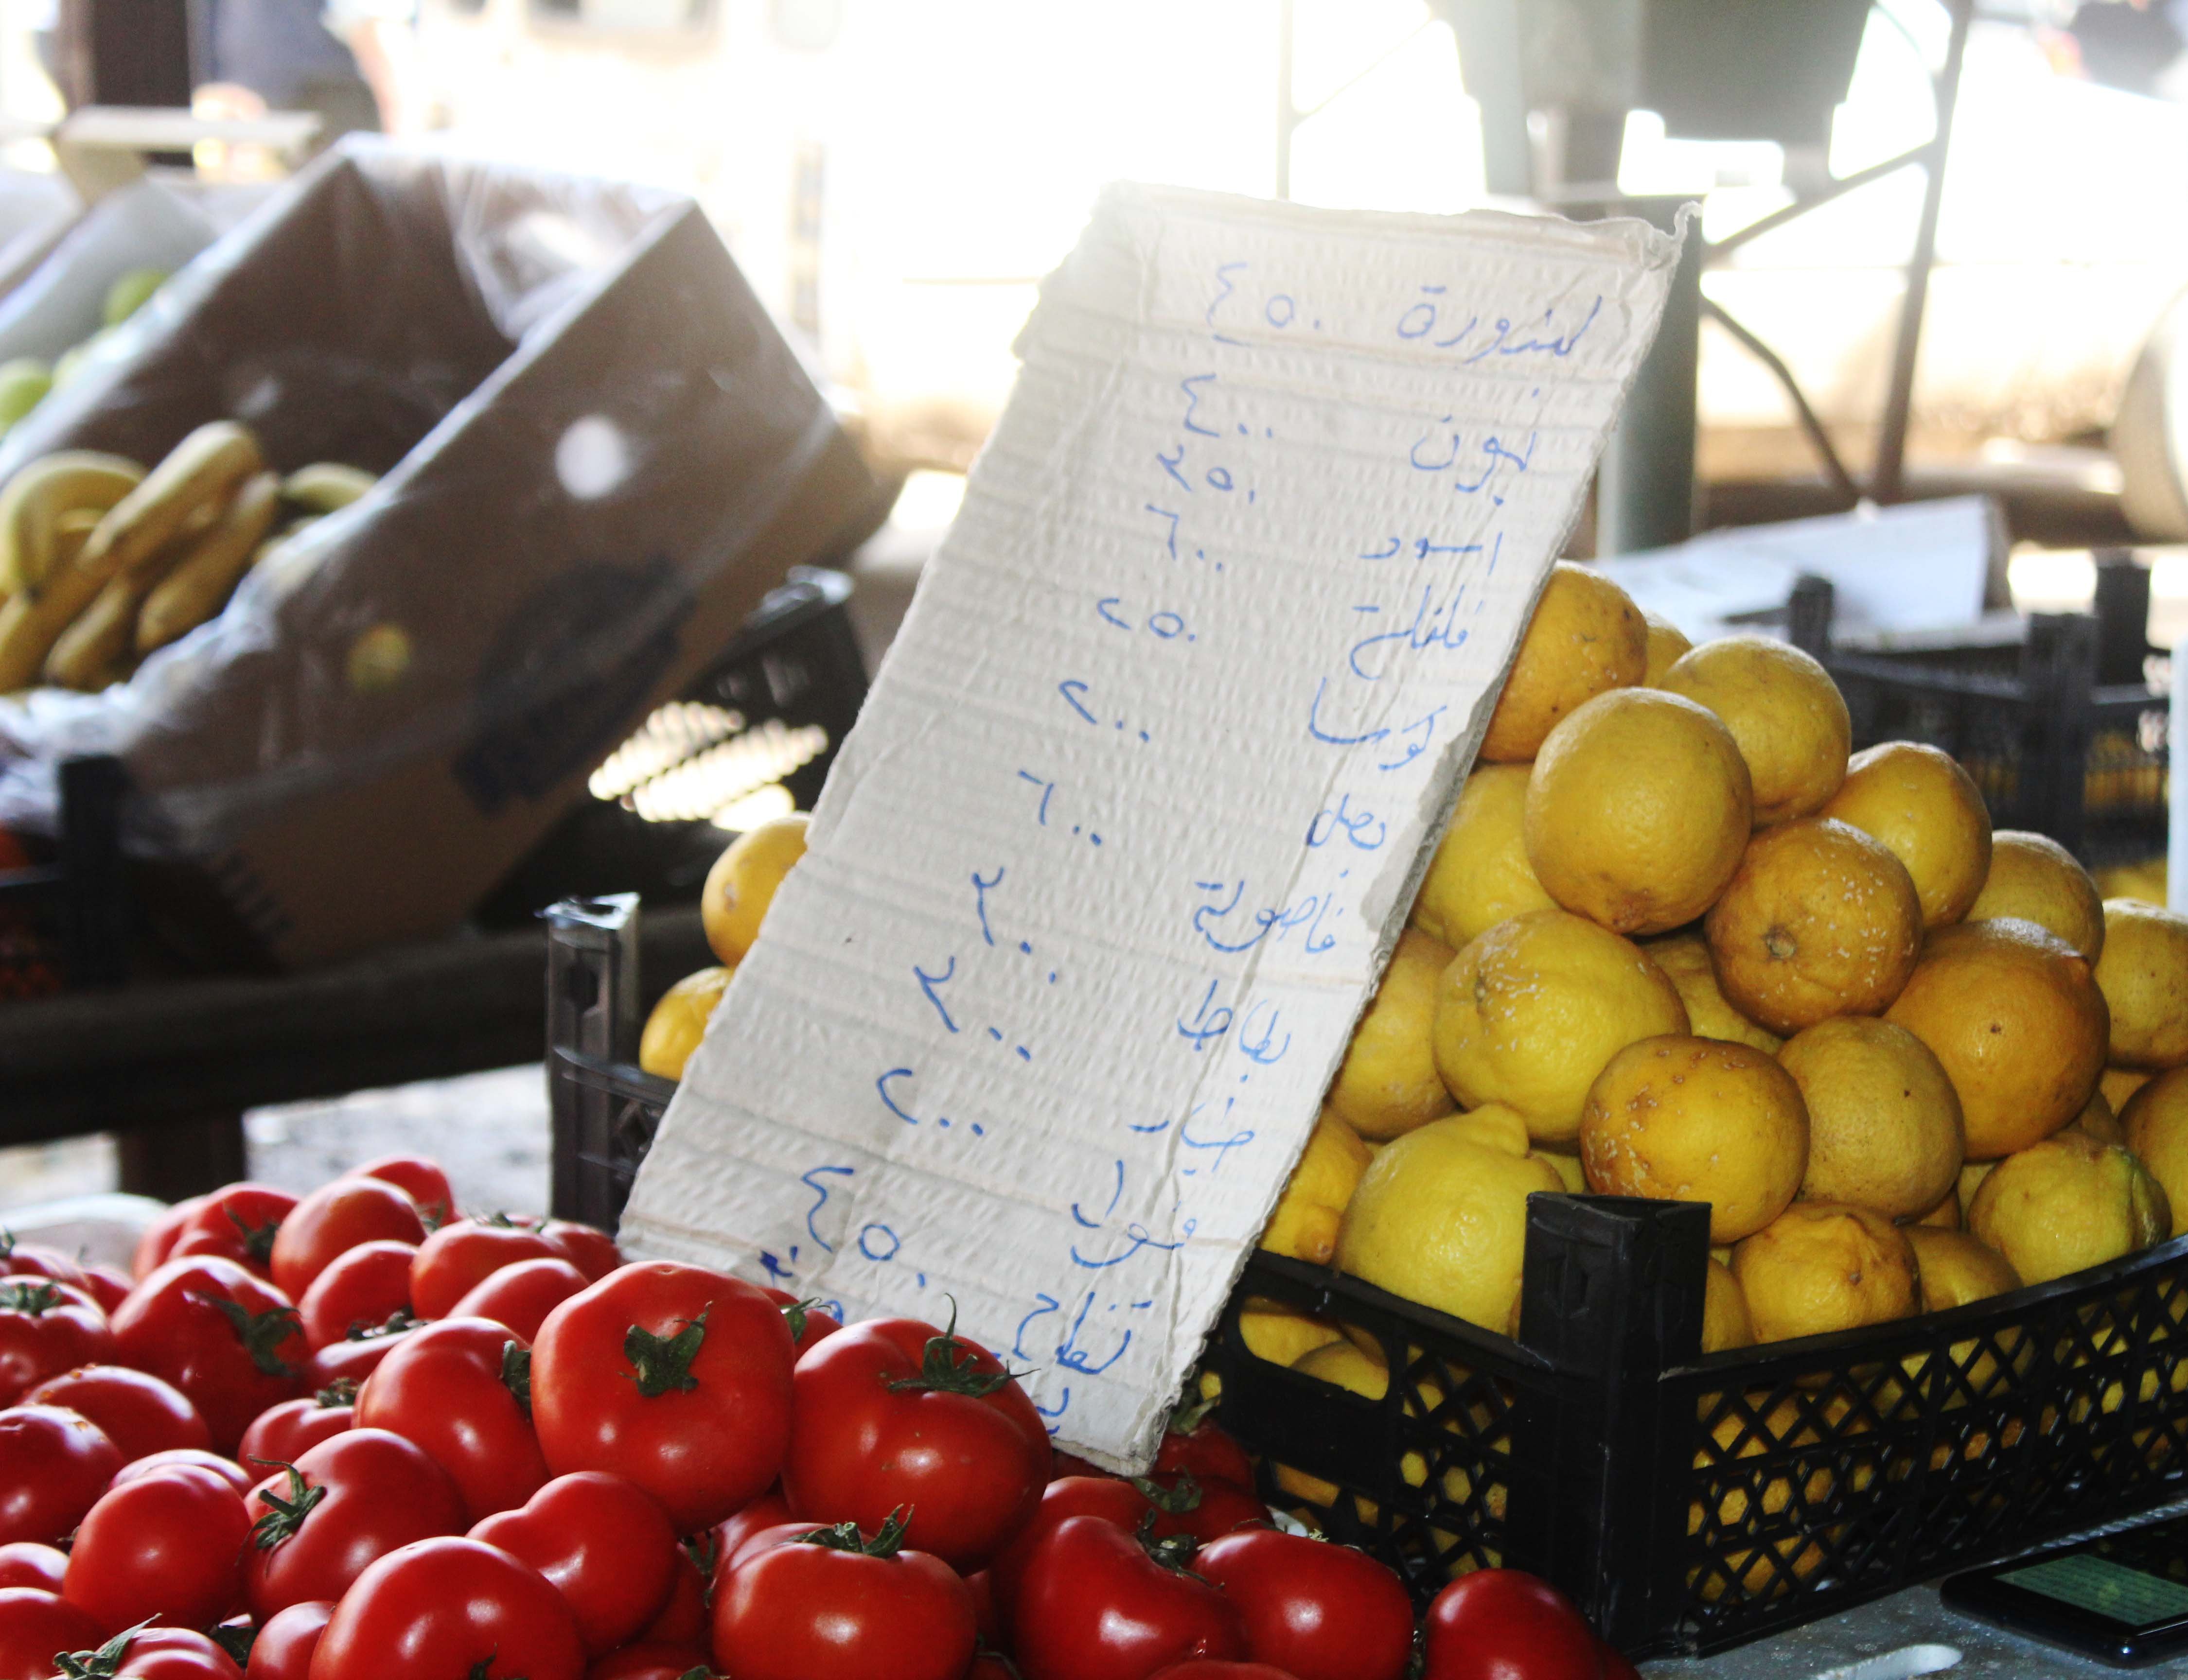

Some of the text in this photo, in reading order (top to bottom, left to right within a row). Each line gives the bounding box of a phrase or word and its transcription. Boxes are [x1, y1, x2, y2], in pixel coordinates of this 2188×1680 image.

[1207, 262, 1321, 346] ٤٥٠
[1182, 373, 1272, 438] ٤٠٠
[1145, 504, 1223, 572] ٦٠٠
[1308, 676, 1447, 771] كوسا
[1017, 770, 1102, 847] ٦٠٠
[801, 1165, 1154, 1375] تفاح ٤٥٠
